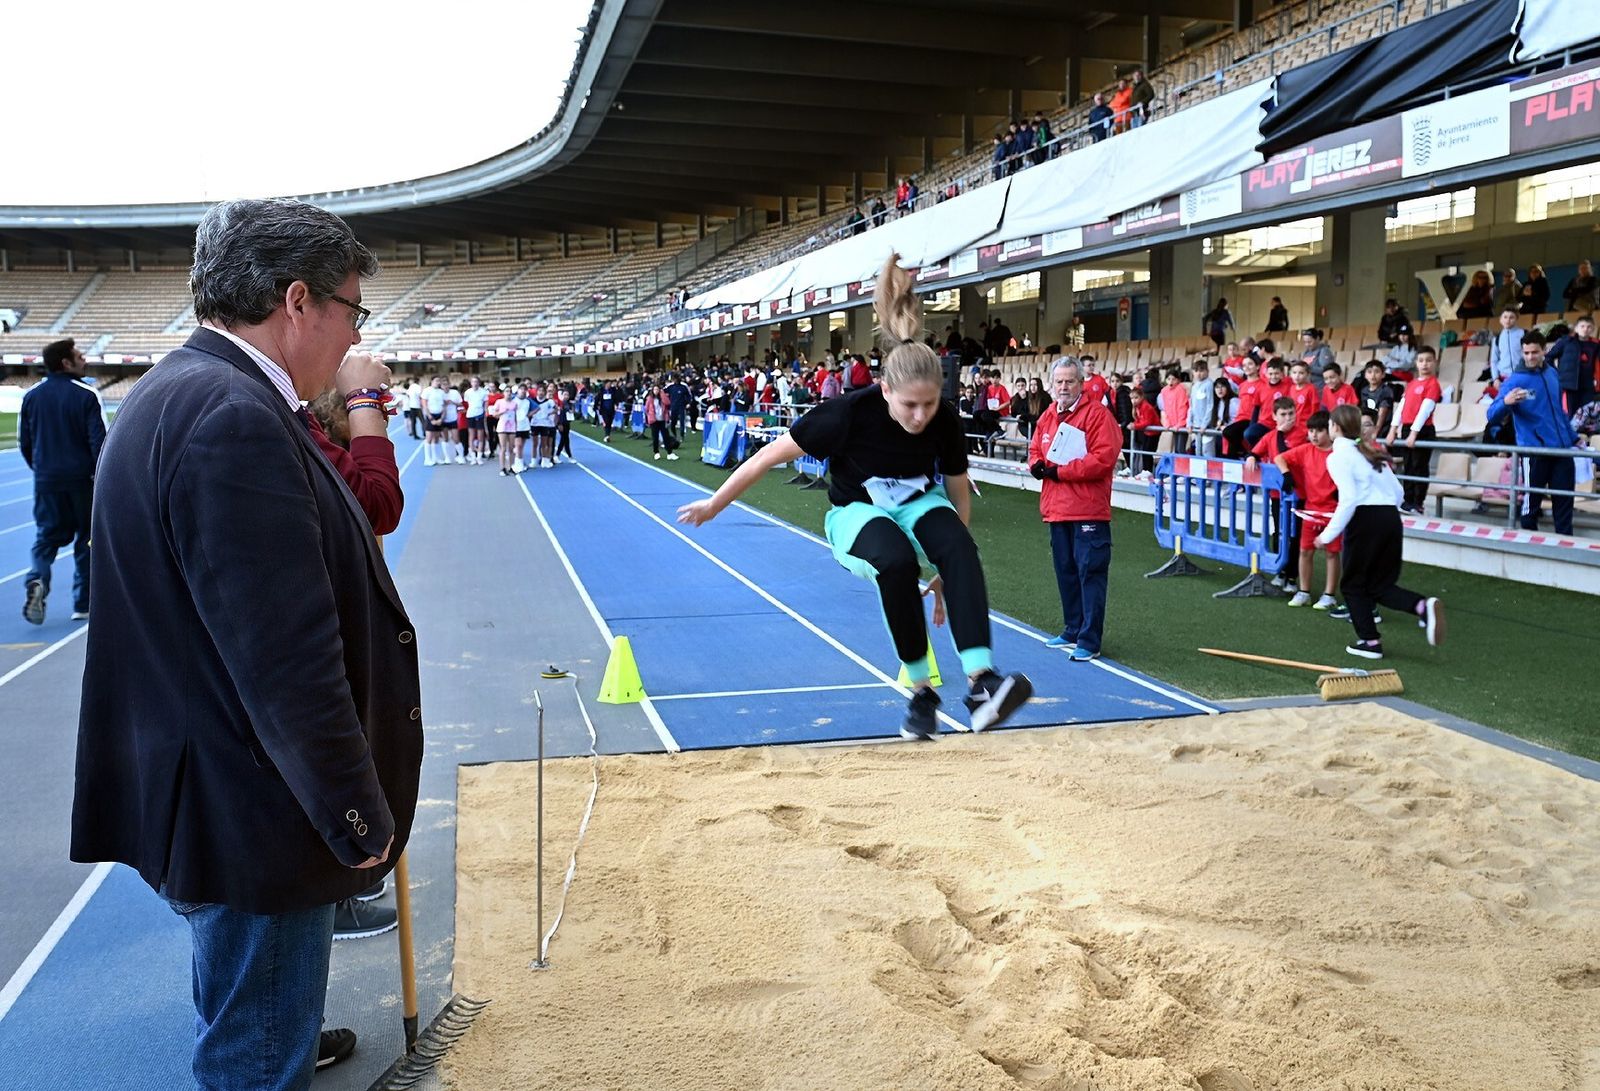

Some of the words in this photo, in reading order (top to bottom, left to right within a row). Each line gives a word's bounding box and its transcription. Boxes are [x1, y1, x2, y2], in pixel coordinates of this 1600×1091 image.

[1525, 79, 1600, 127] PLA
[1437, 115, 1498, 137] Ayuntamiento
[1437, 139, 1446, 148] de
[1248, 159, 1300, 192] PLAY
[1290, 139, 1372, 194] JEREZ
